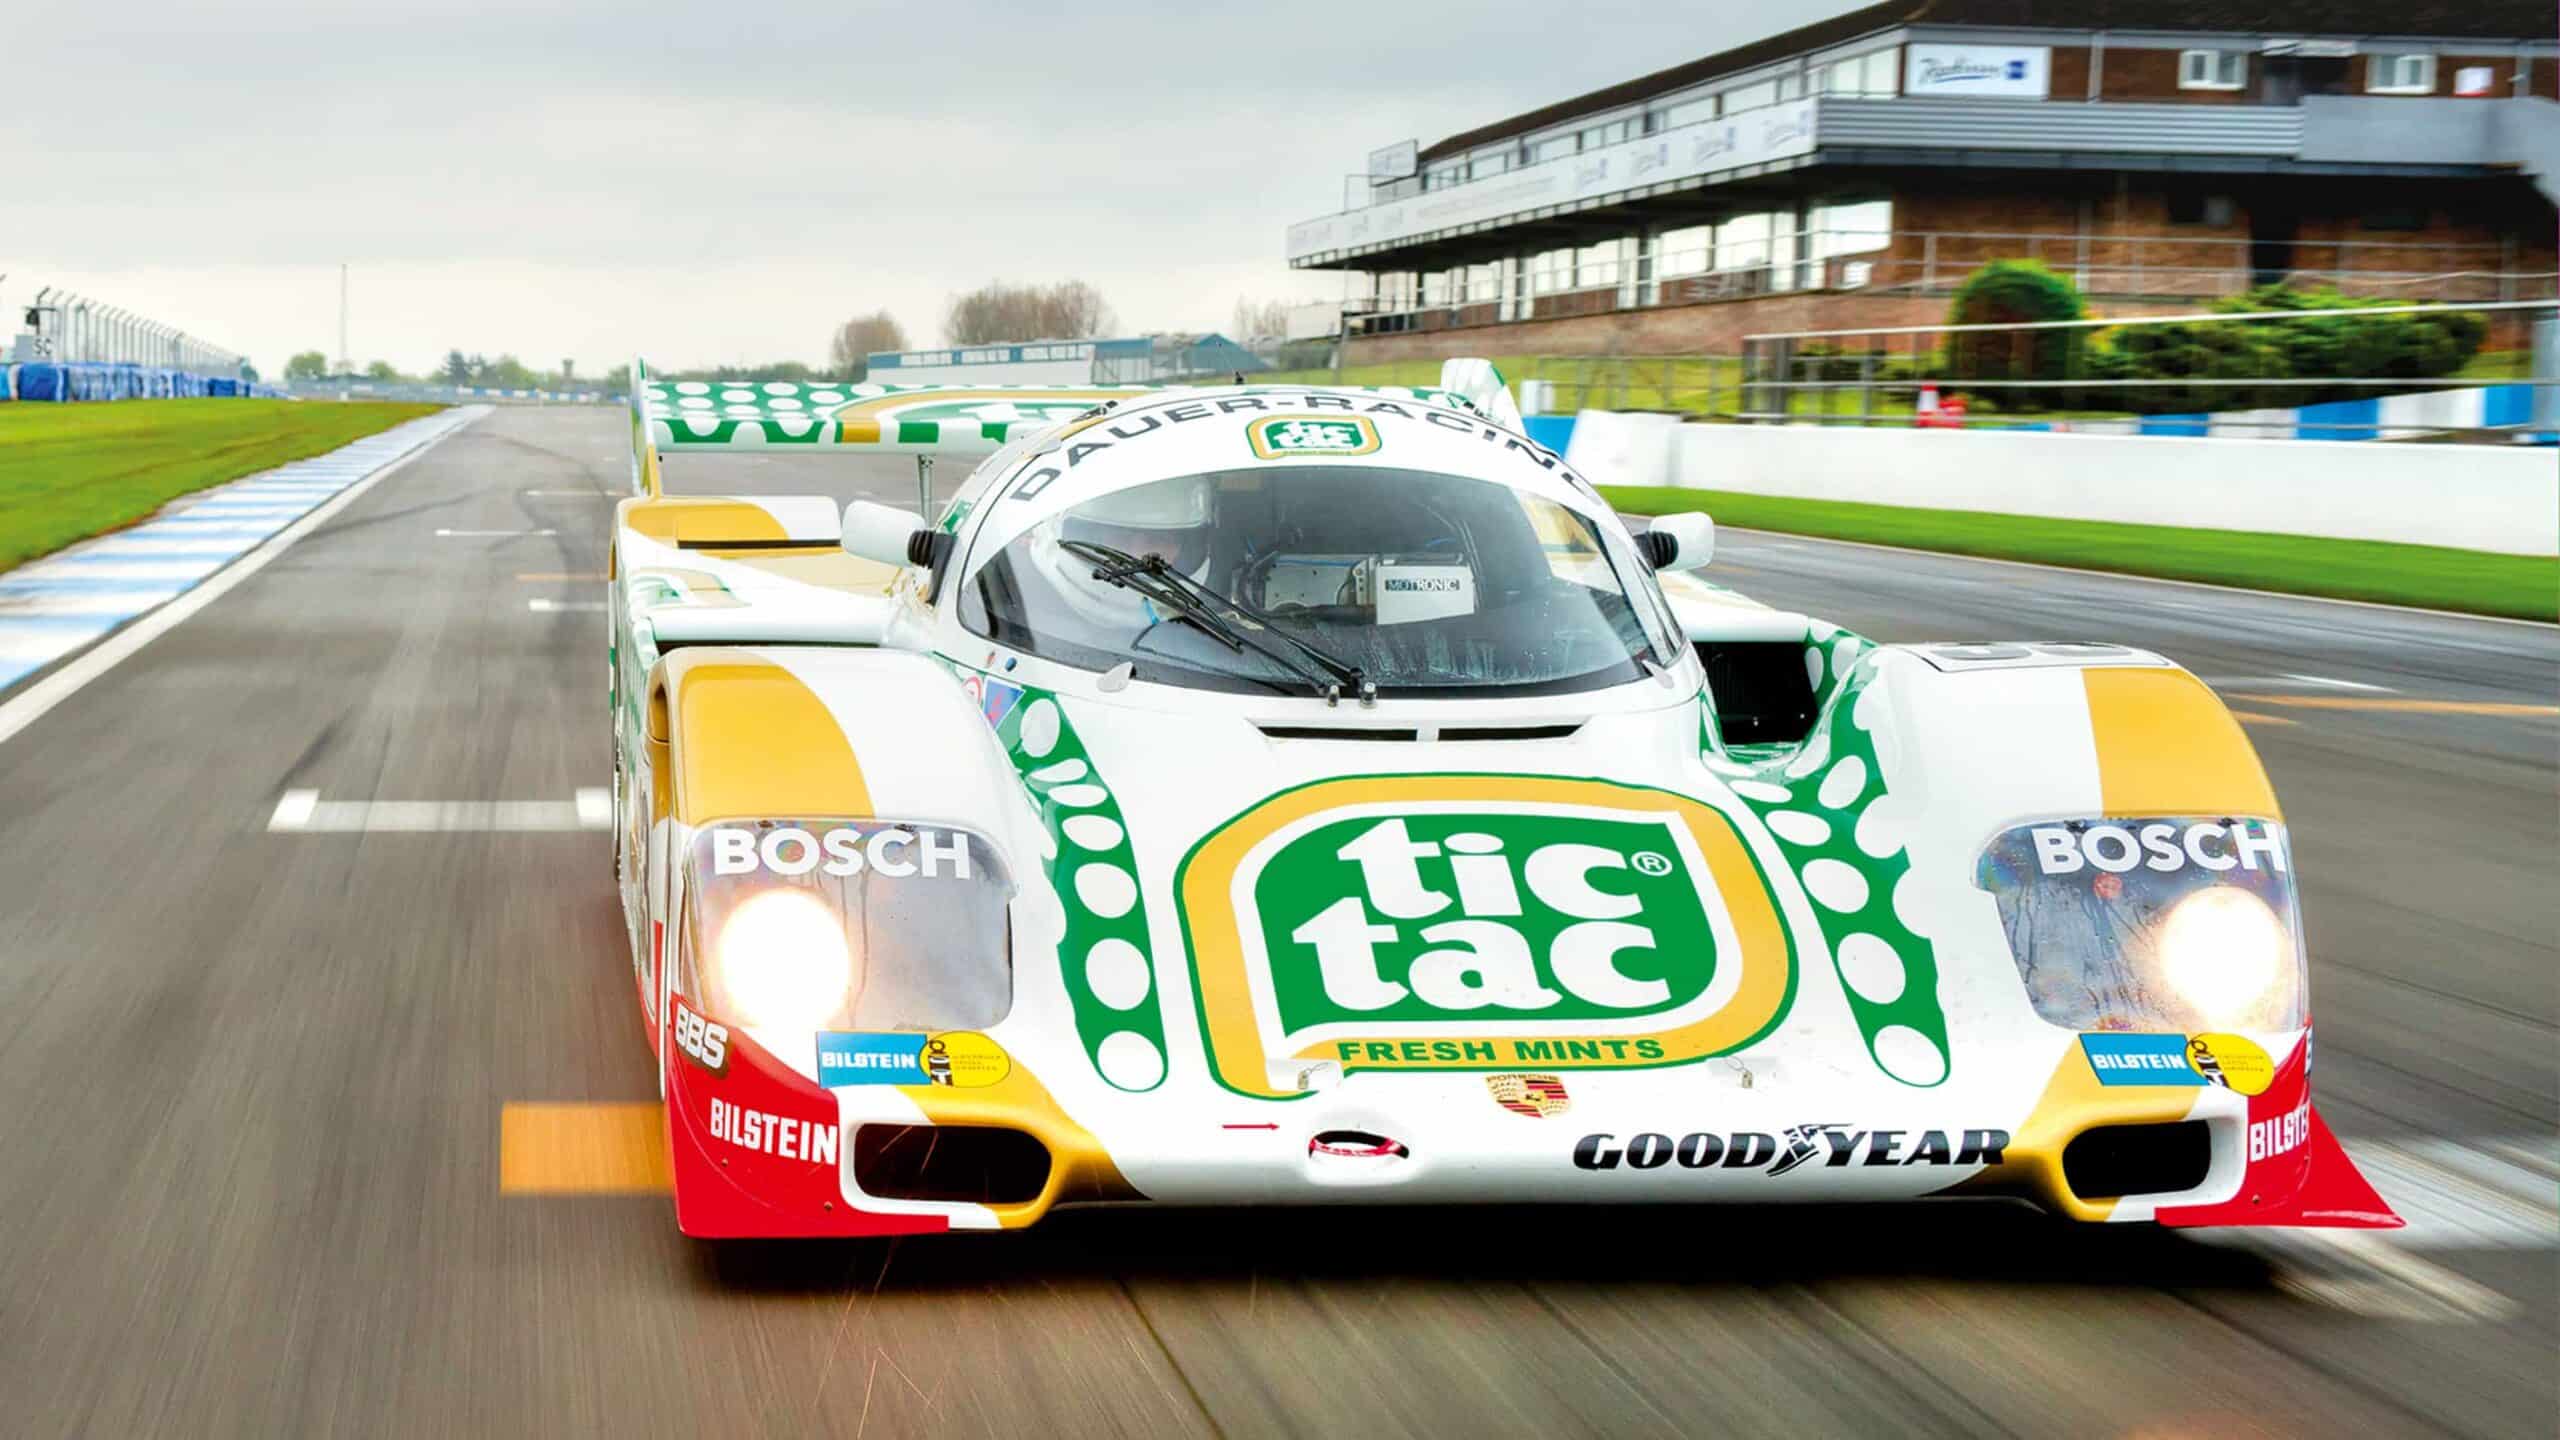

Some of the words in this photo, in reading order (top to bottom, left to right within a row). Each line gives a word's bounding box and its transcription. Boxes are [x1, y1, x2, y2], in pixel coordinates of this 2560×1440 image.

[1385, 578, 1460, 592] MOTRONIC
[713, 828, 972, 880] BOSCH
[2031, 823, 2287, 875] BOSCH
[1291, 896, 1673, 1011] tac
[676, 1003, 729, 1070] BBS
[821, 1051, 917, 1069] BILSTEIN
[1336, 1041, 1497, 1062] FRESH
[1514, 1039, 1665, 1060] MINTS
[2090, 1053, 2188, 1070] BILSTEIN
[711, 1096, 839, 1166] BILSTEIN
